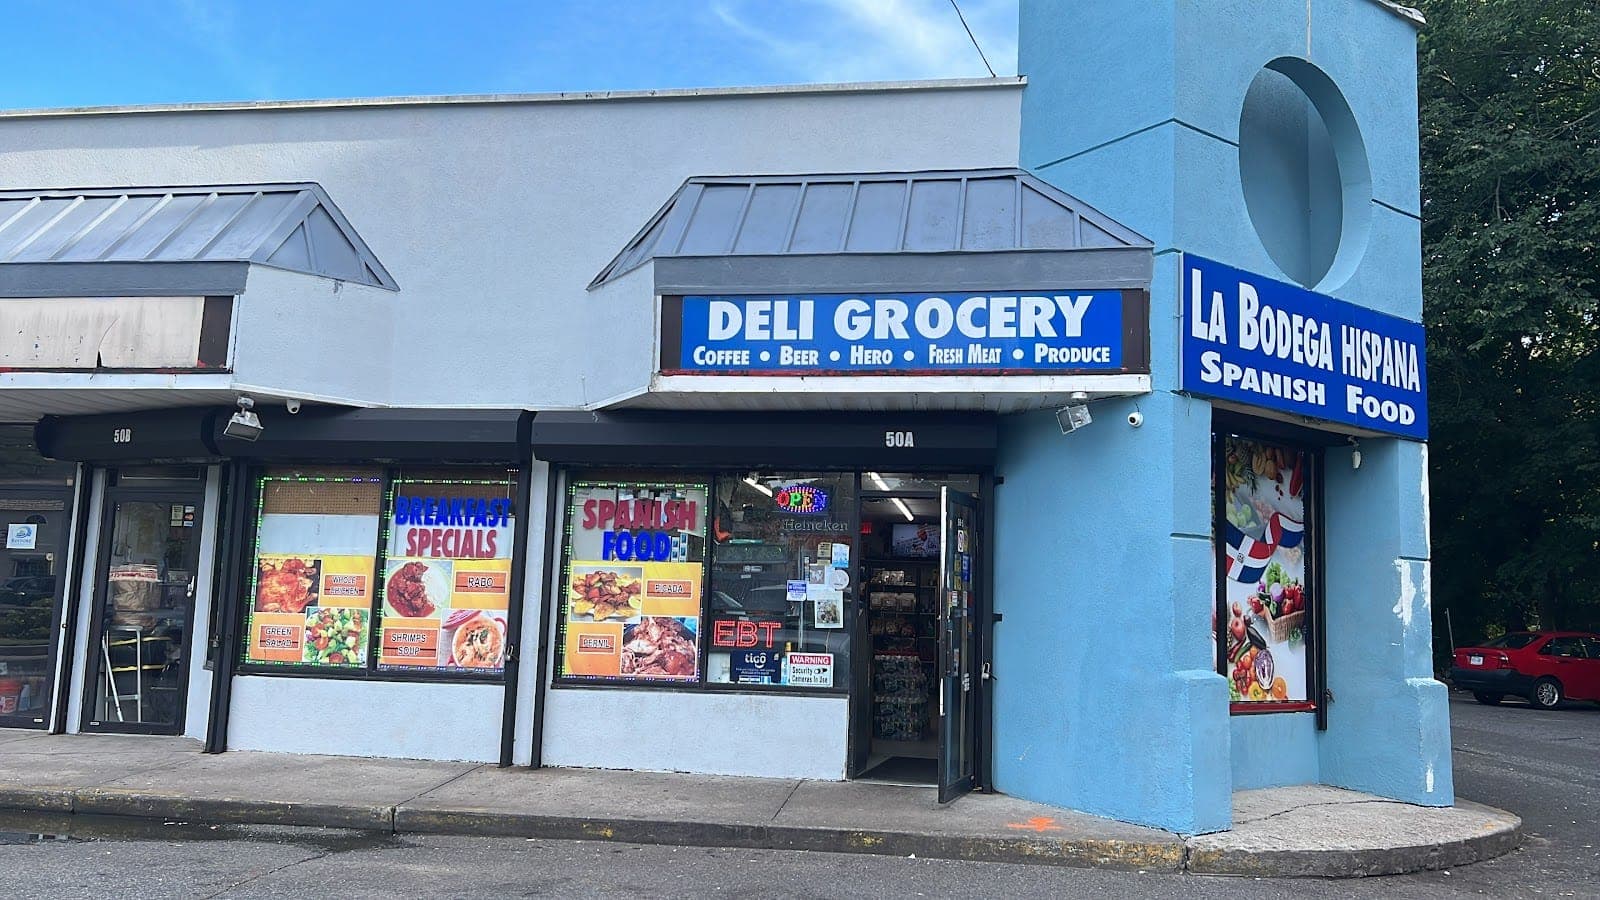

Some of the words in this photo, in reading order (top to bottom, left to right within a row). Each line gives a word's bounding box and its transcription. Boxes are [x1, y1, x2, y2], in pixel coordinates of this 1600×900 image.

[708, 300, 814, 341] DELI
[833, 295, 1093, 340] GROCERY
[1191, 268, 1227, 345] LA
[1239, 282, 1333, 371] BODEGA
[1341, 324, 1421, 392] HISPANA
[693, 346, 750, 365] COFFEE
[779, 345, 819, 365] BEER
[850, 345, 893, 365] HERO
[929, 344, 963, 364] FRESH
[968, 344, 1002, 364] MEAT
[1034, 343, 1110, 363] PRODUCE
[1201, 351, 1326, 406] SPANISH
[1346, 384, 1415, 426] FOOD
[114, 429, 131, 443] 50B
[885, 431, 914, 448] 50A
[776, 491, 828, 508] OPEN
[395, 496, 512, 528] BREAKFAST
[583, 499, 697, 530] SPANISH
[784, 519, 849, 532] Heineken
[406, 528, 497, 558] SPECIALS
[602, 531, 671, 561] FOOD
[468, 577, 494, 588] RABO
[265, 627, 292, 637] GREEN
[713, 620, 781, 648] EBT
[265, 639, 292, 649] SALAD
[398, 646, 421, 656] SOUP
[791, 656, 830, 666] WARNING
[791, 666, 813, 677] Security
[791, 676, 813, 684] Cameras
